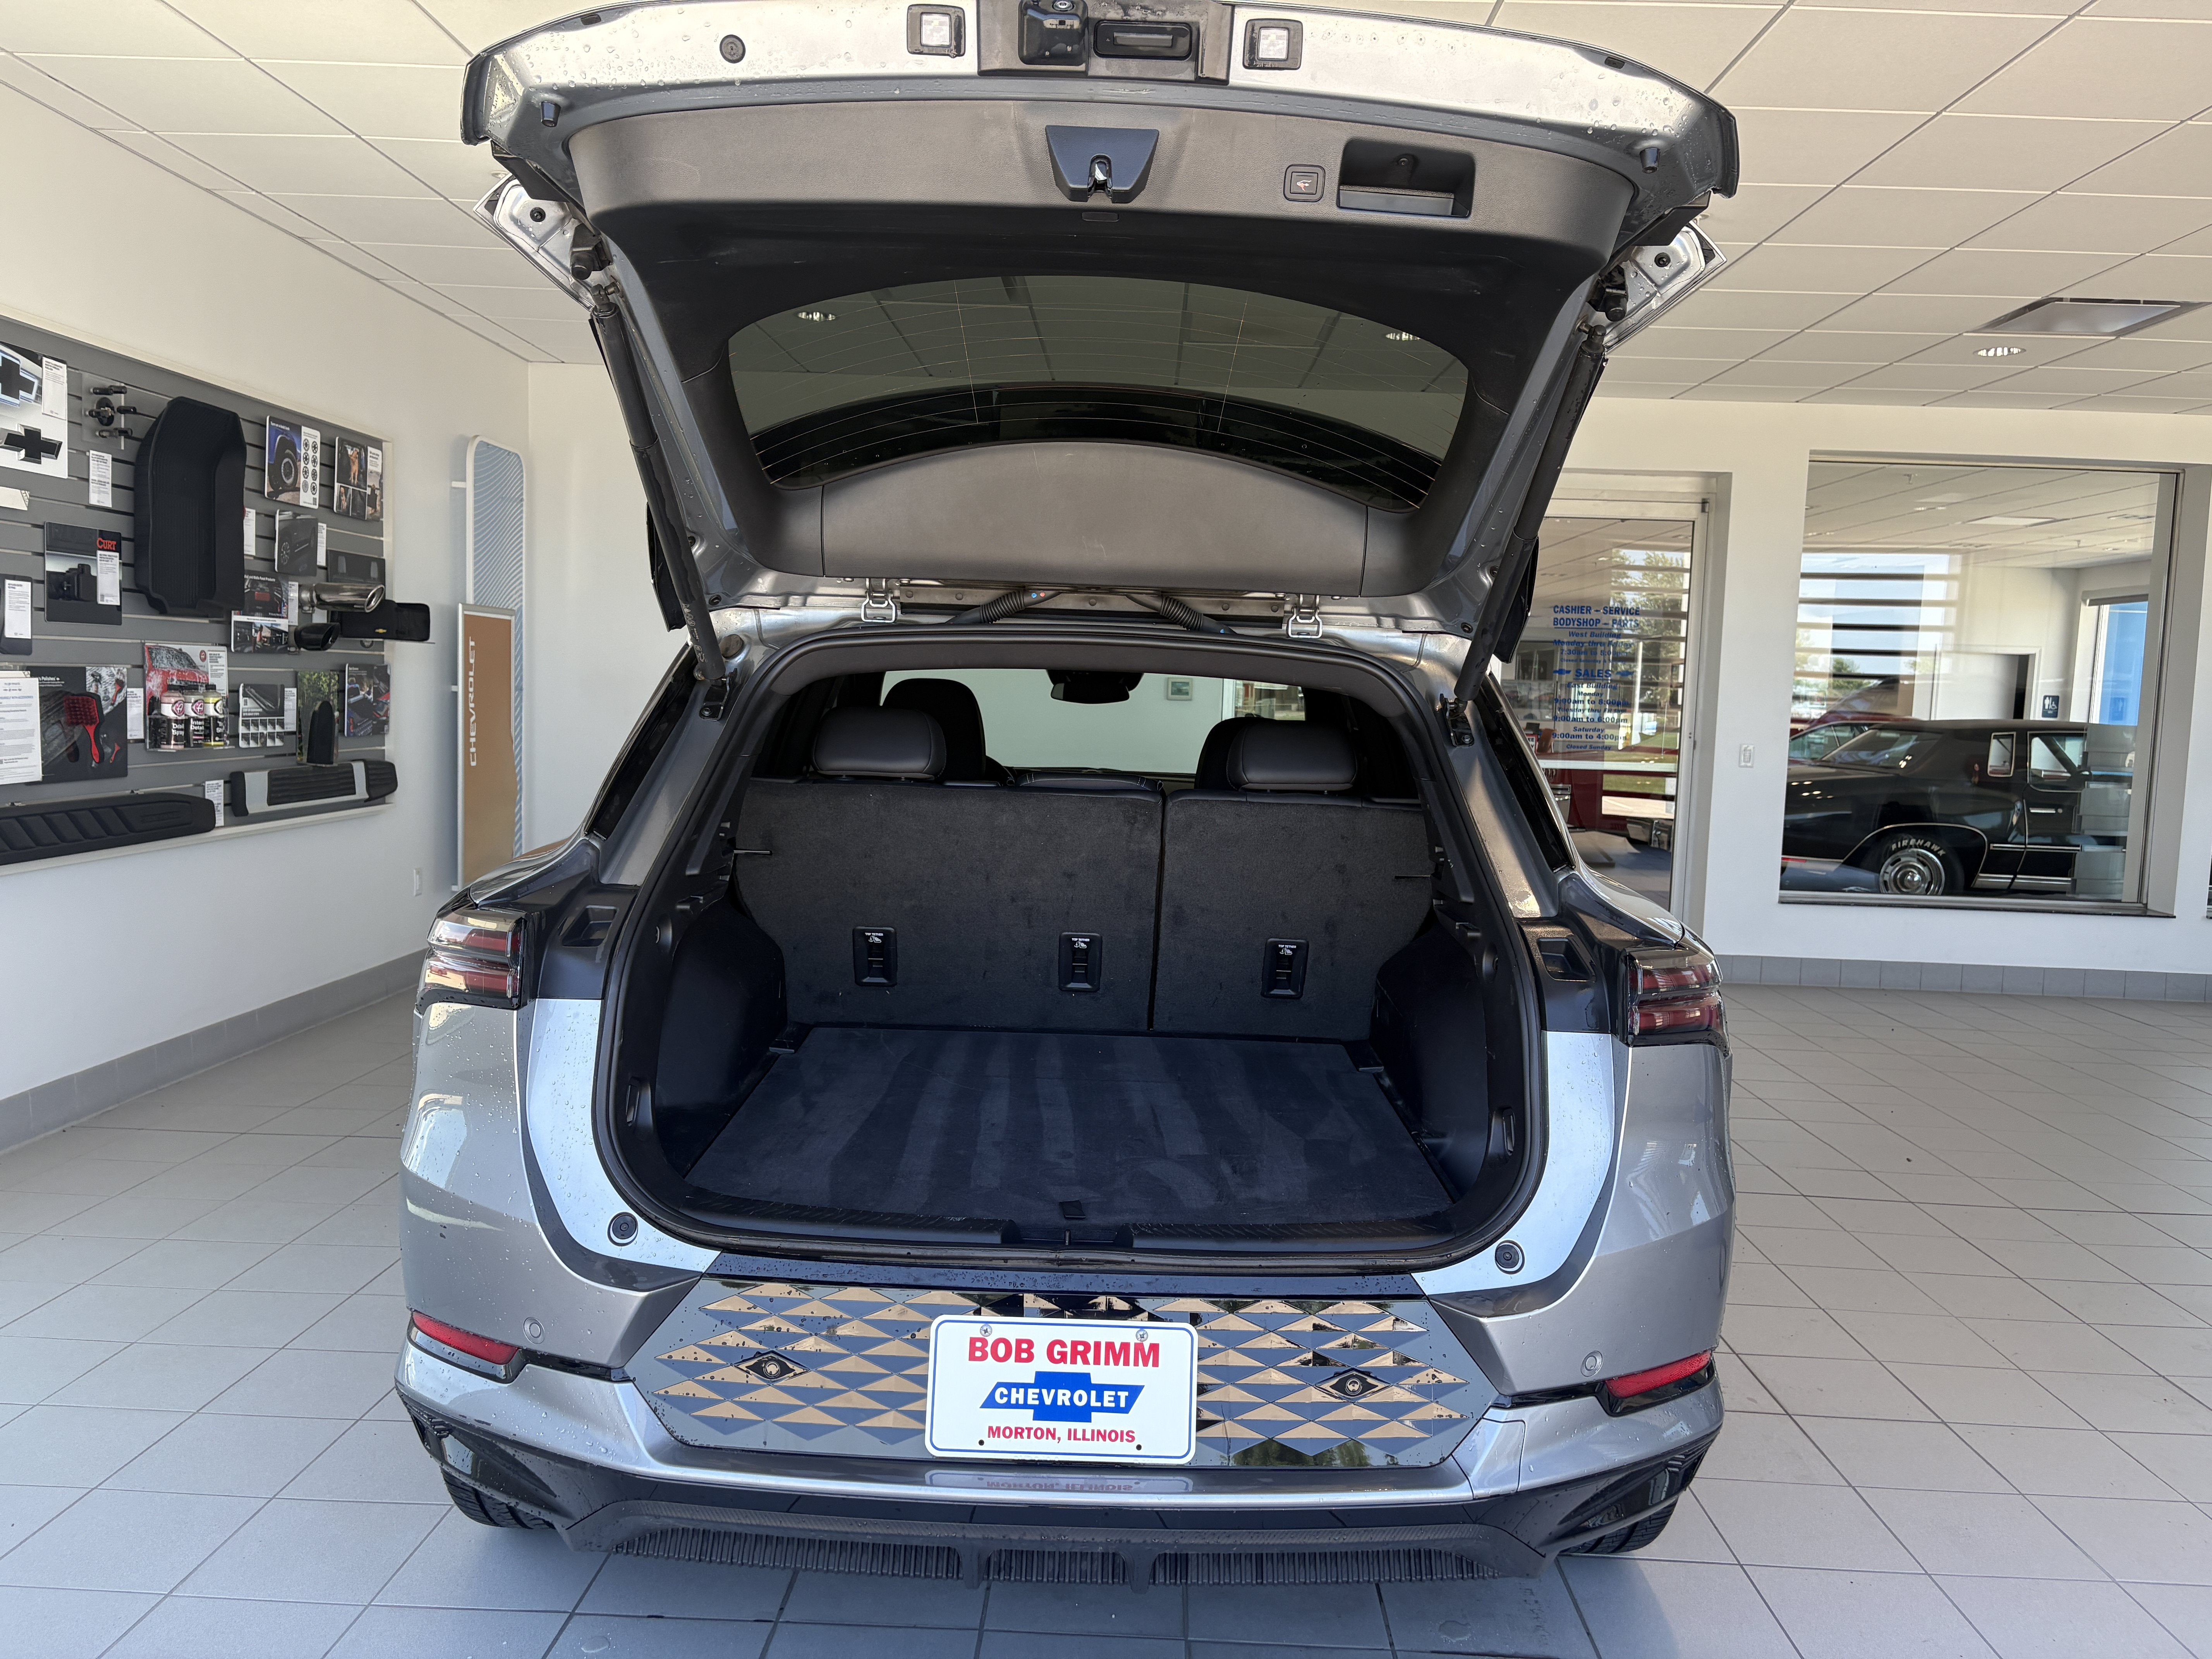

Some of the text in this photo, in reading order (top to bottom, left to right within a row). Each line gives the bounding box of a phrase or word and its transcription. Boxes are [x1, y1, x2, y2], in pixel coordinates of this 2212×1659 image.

[97, 538, 117, 550] CURT
[1553, 605, 1640, 615] CASHIER SERVICE
[1553, 617, 1639, 627] BODYSHOP PARTS
[1553, 639, 1585, 647] Monday
[1575, 669, 1612, 678] SALES
[1892, 839, 1946, 856] FIREHAWK
[968, 1337, 1159, 1367] BOB GRIMM
[994, 1387, 1129, 1408] CHEVROLET
[988, 1425, 1135, 1444] MORTON, ILLINOIS
